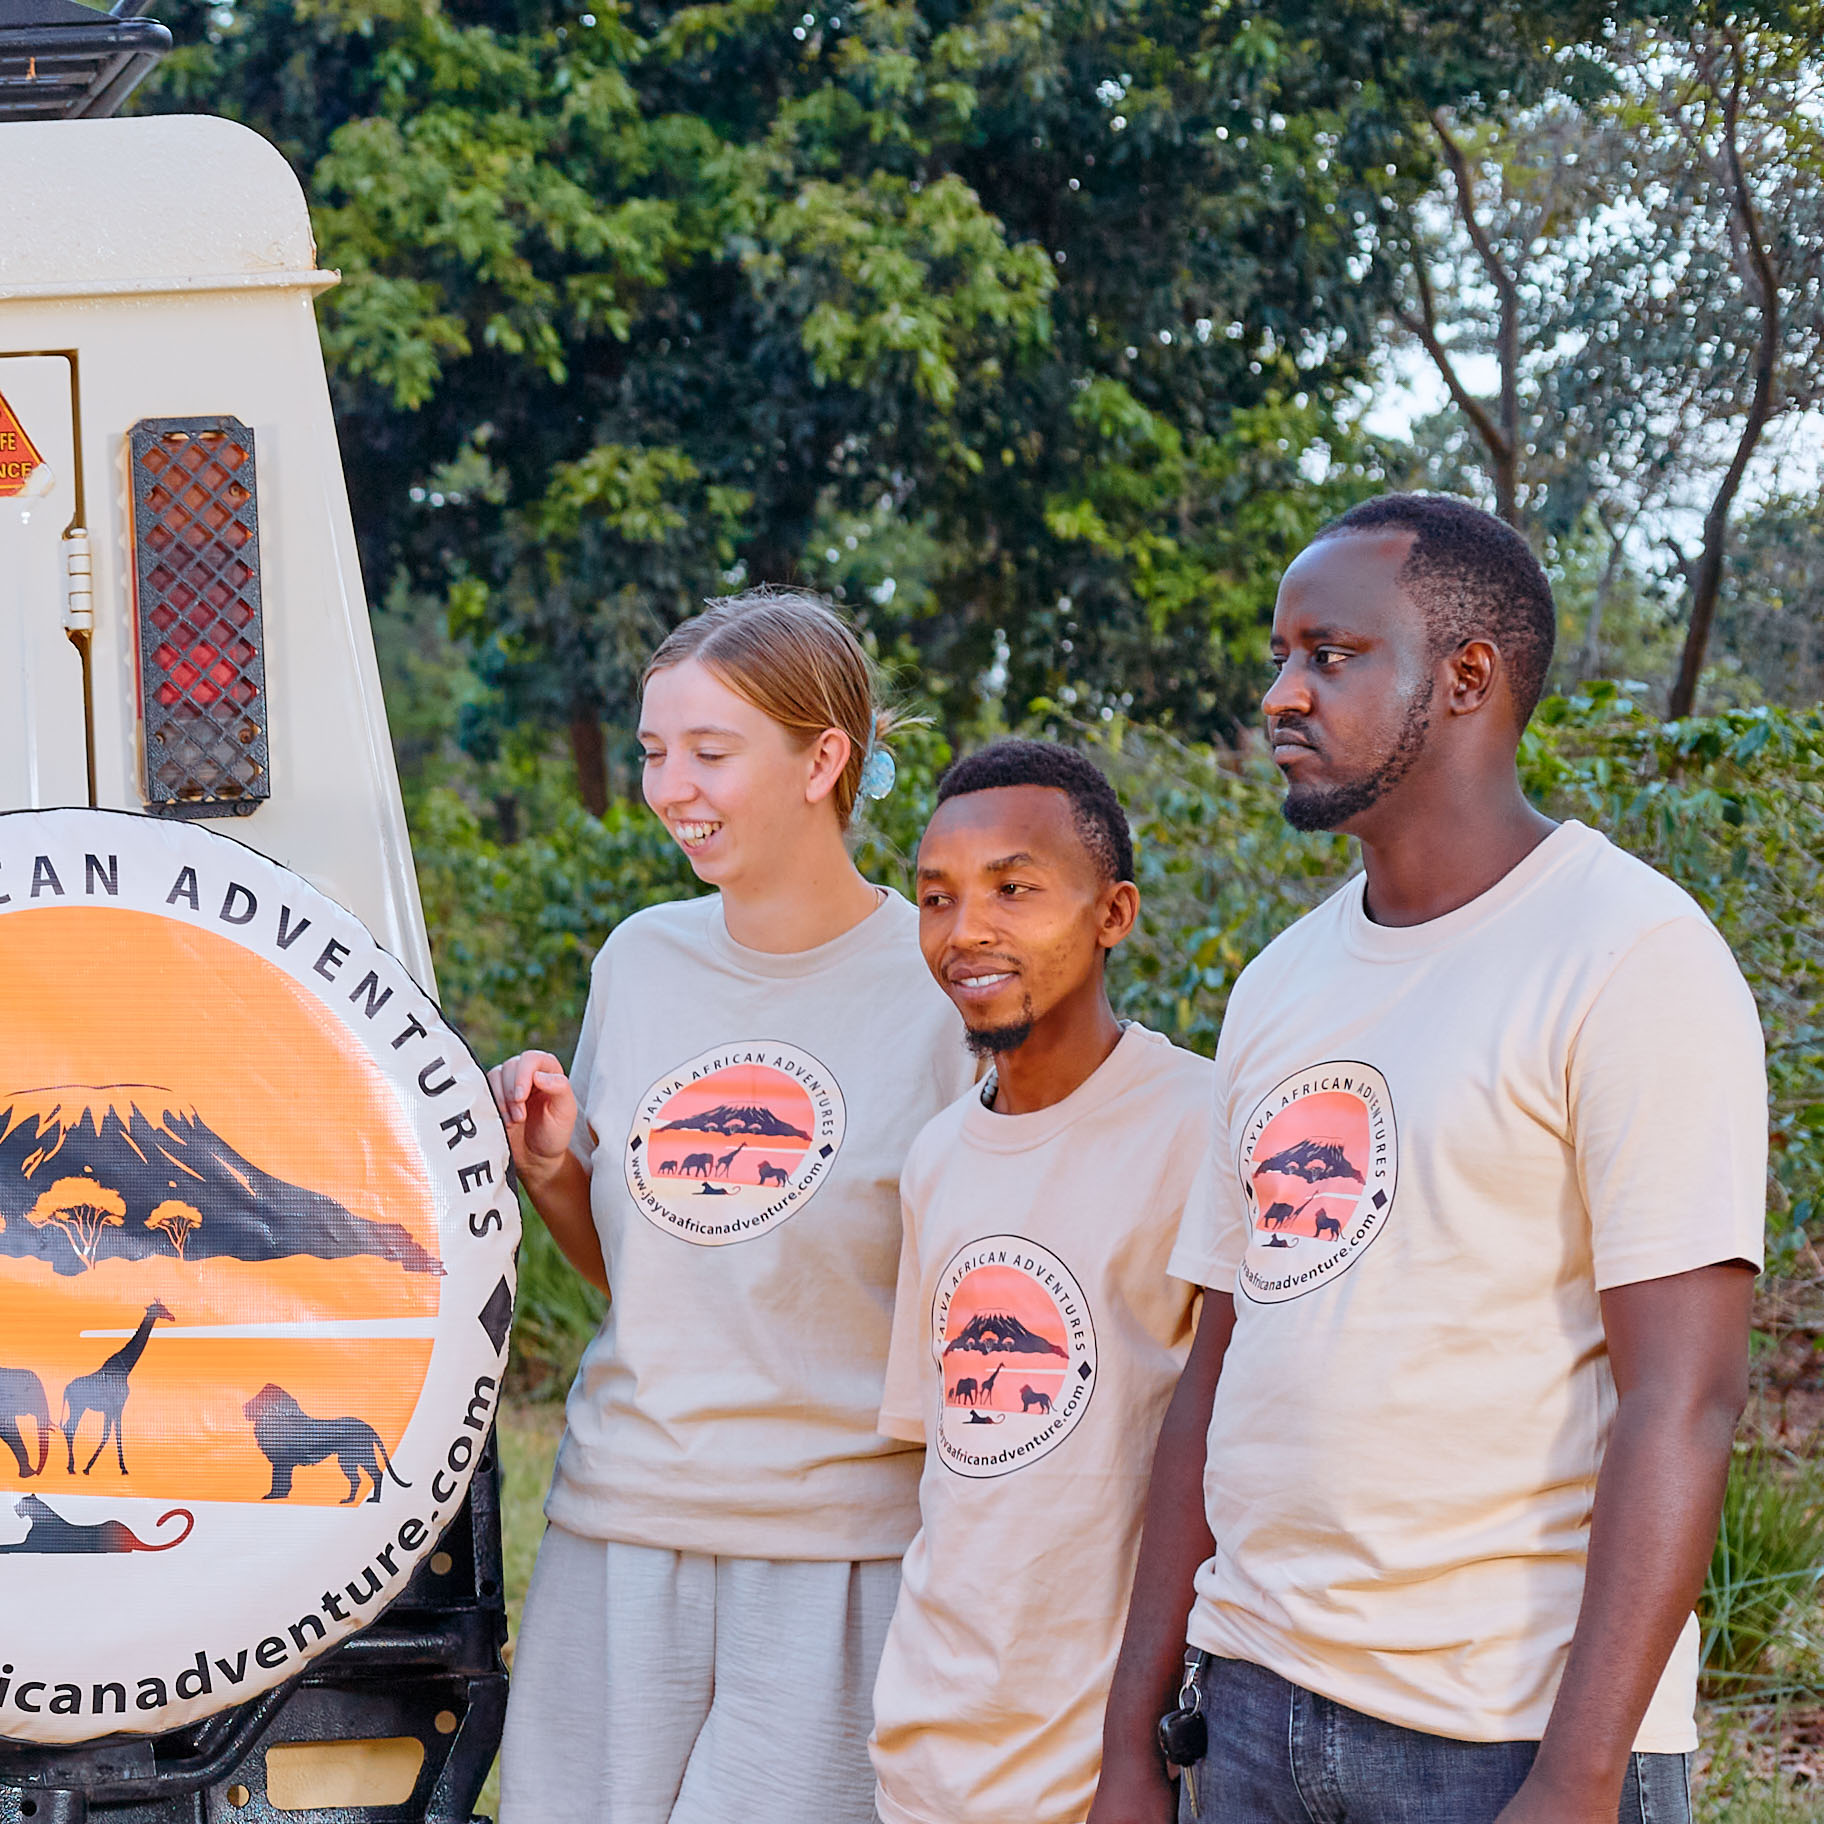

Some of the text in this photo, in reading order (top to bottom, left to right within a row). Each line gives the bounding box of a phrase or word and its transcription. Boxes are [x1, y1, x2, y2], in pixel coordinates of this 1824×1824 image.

[166, 865, 502, 1239] ADVENTURES
[643, 1053, 834, 1136] JAYVA AFRICAN ADVENTURES
[1280, 1078, 1353, 1108] AFRICAN
[1357, 1083, 1386, 1178] ADVENTURES
[632, 1156, 823, 1235] www.jayvaafricanadventure.com
[952, 1251, 1007, 1288] AFRICAN
[1013, 1254, 1086, 1351] ADVENTURES
